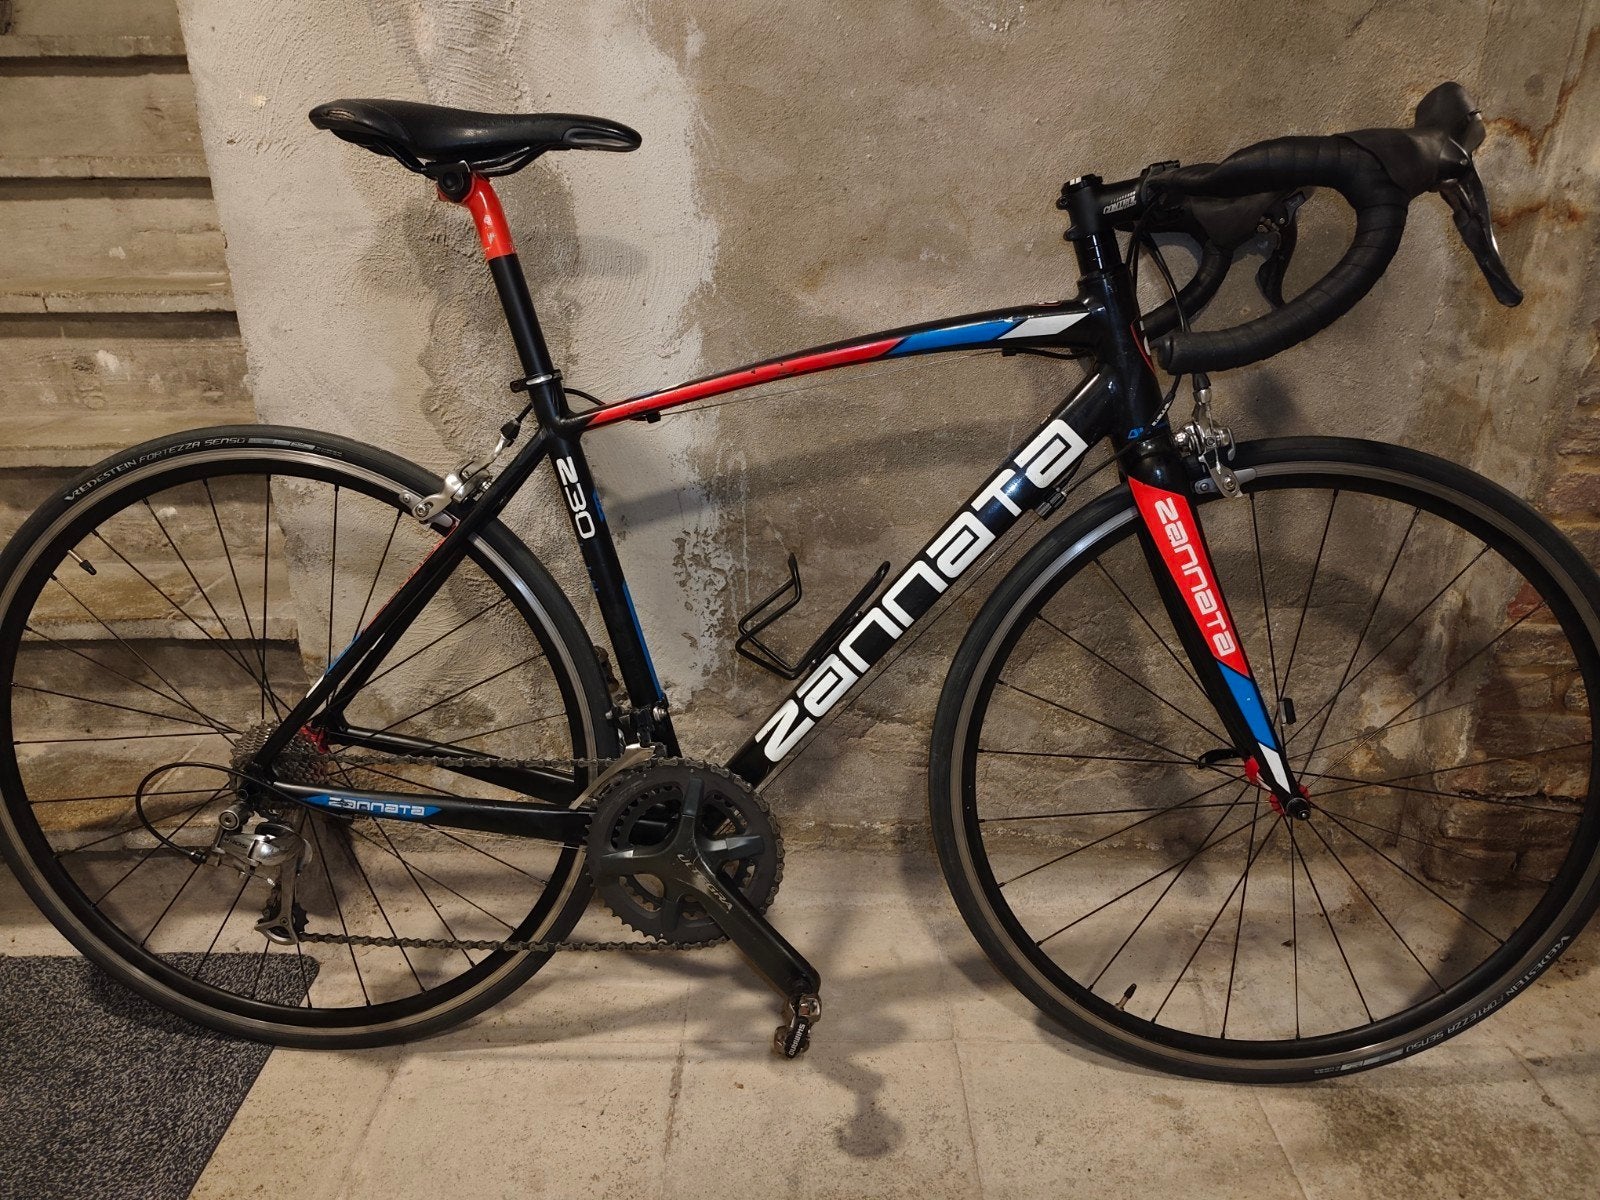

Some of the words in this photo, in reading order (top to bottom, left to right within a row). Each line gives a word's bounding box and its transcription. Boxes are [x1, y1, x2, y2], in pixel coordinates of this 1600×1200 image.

[63, 459, 138, 501] VREDESTEIN
[139, 439, 201, 464] FORTEZZA
[754, 418, 1089, 763] zannata
[1154, 496, 1237, 658] zannata
[328, 796, 426, 817] zannata
[1505, 935, 1571, 997] VREDESTEIN
[788, 1023, 806, 1056] SHIMANO
